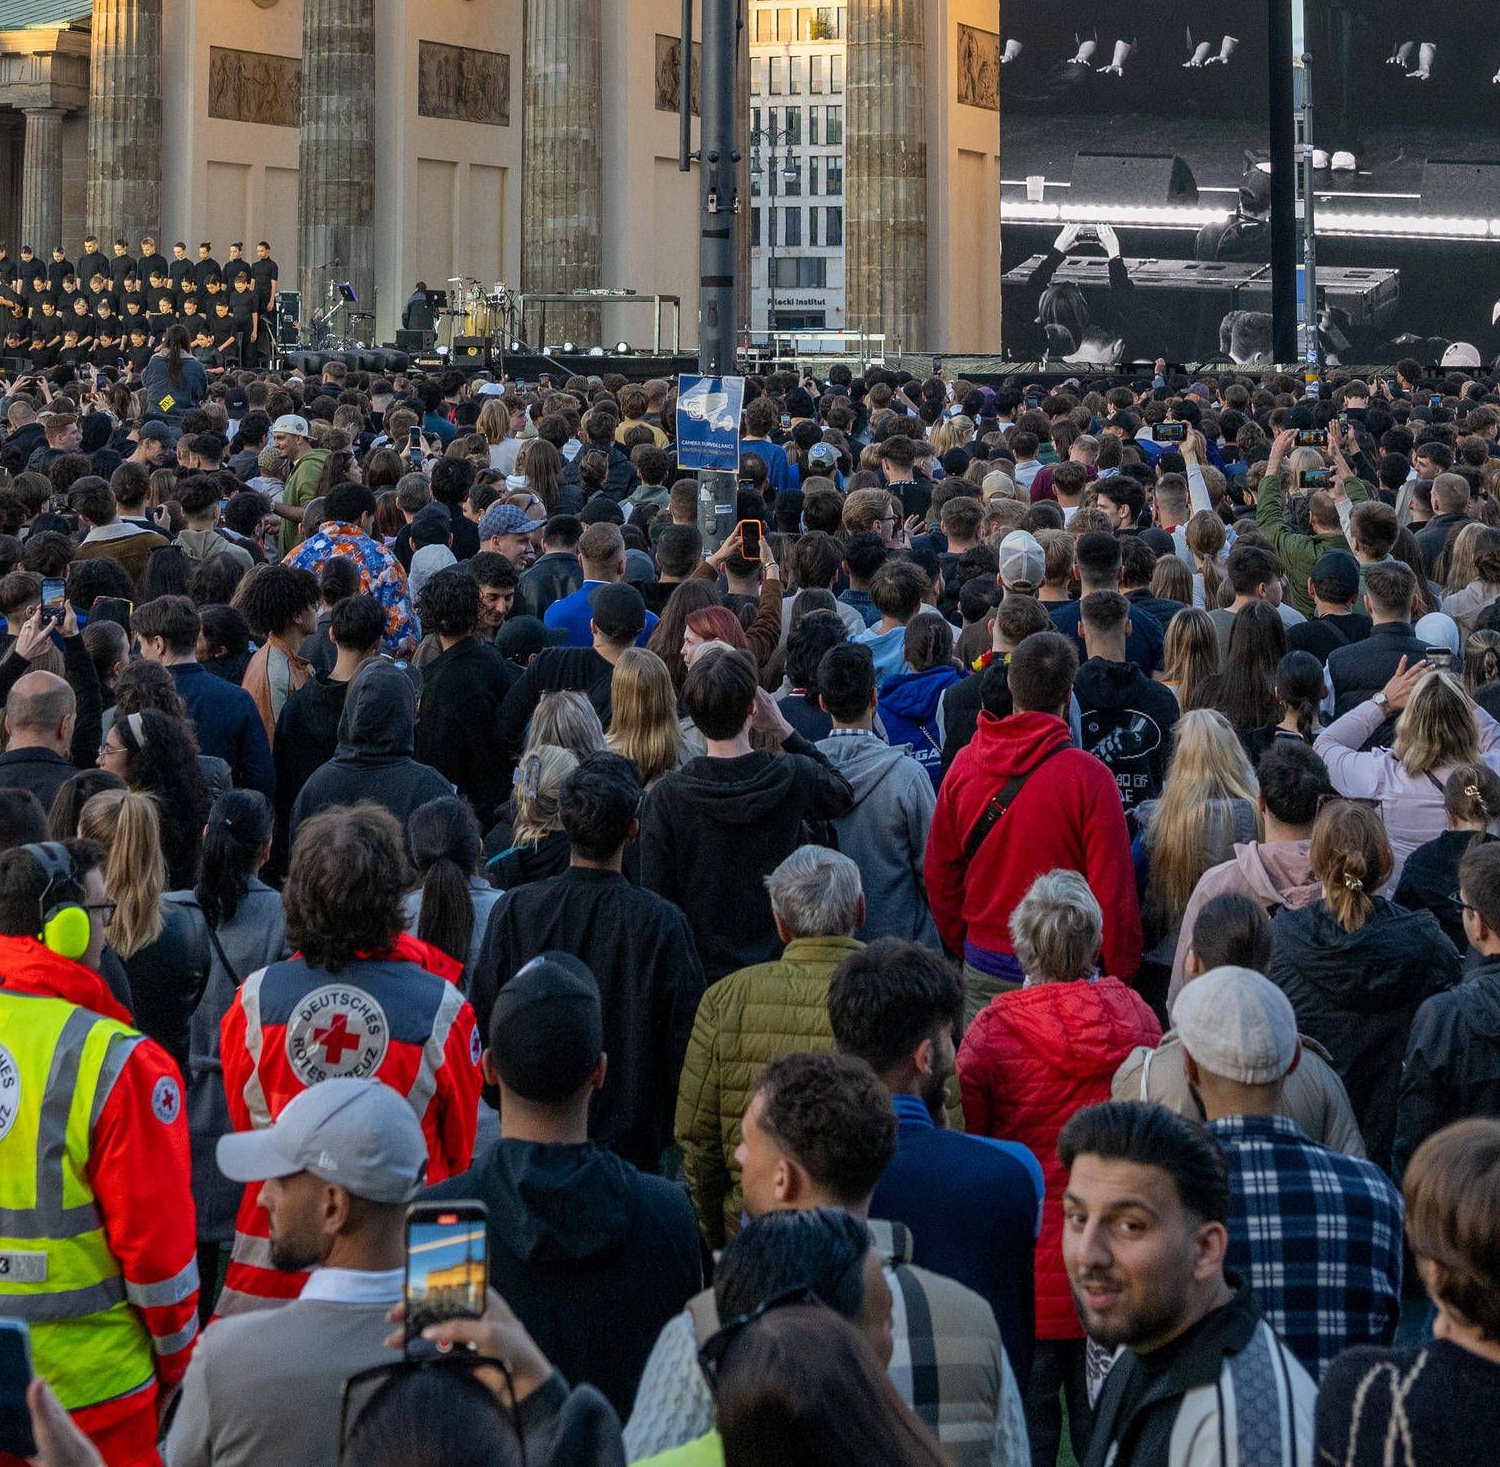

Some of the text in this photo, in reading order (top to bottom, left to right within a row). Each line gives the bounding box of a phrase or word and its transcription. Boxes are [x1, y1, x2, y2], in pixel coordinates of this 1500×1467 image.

[301, 993, 380, 1035] DEUTSCHES
[293, 1038, 379, 1083] ROTES REUZ
